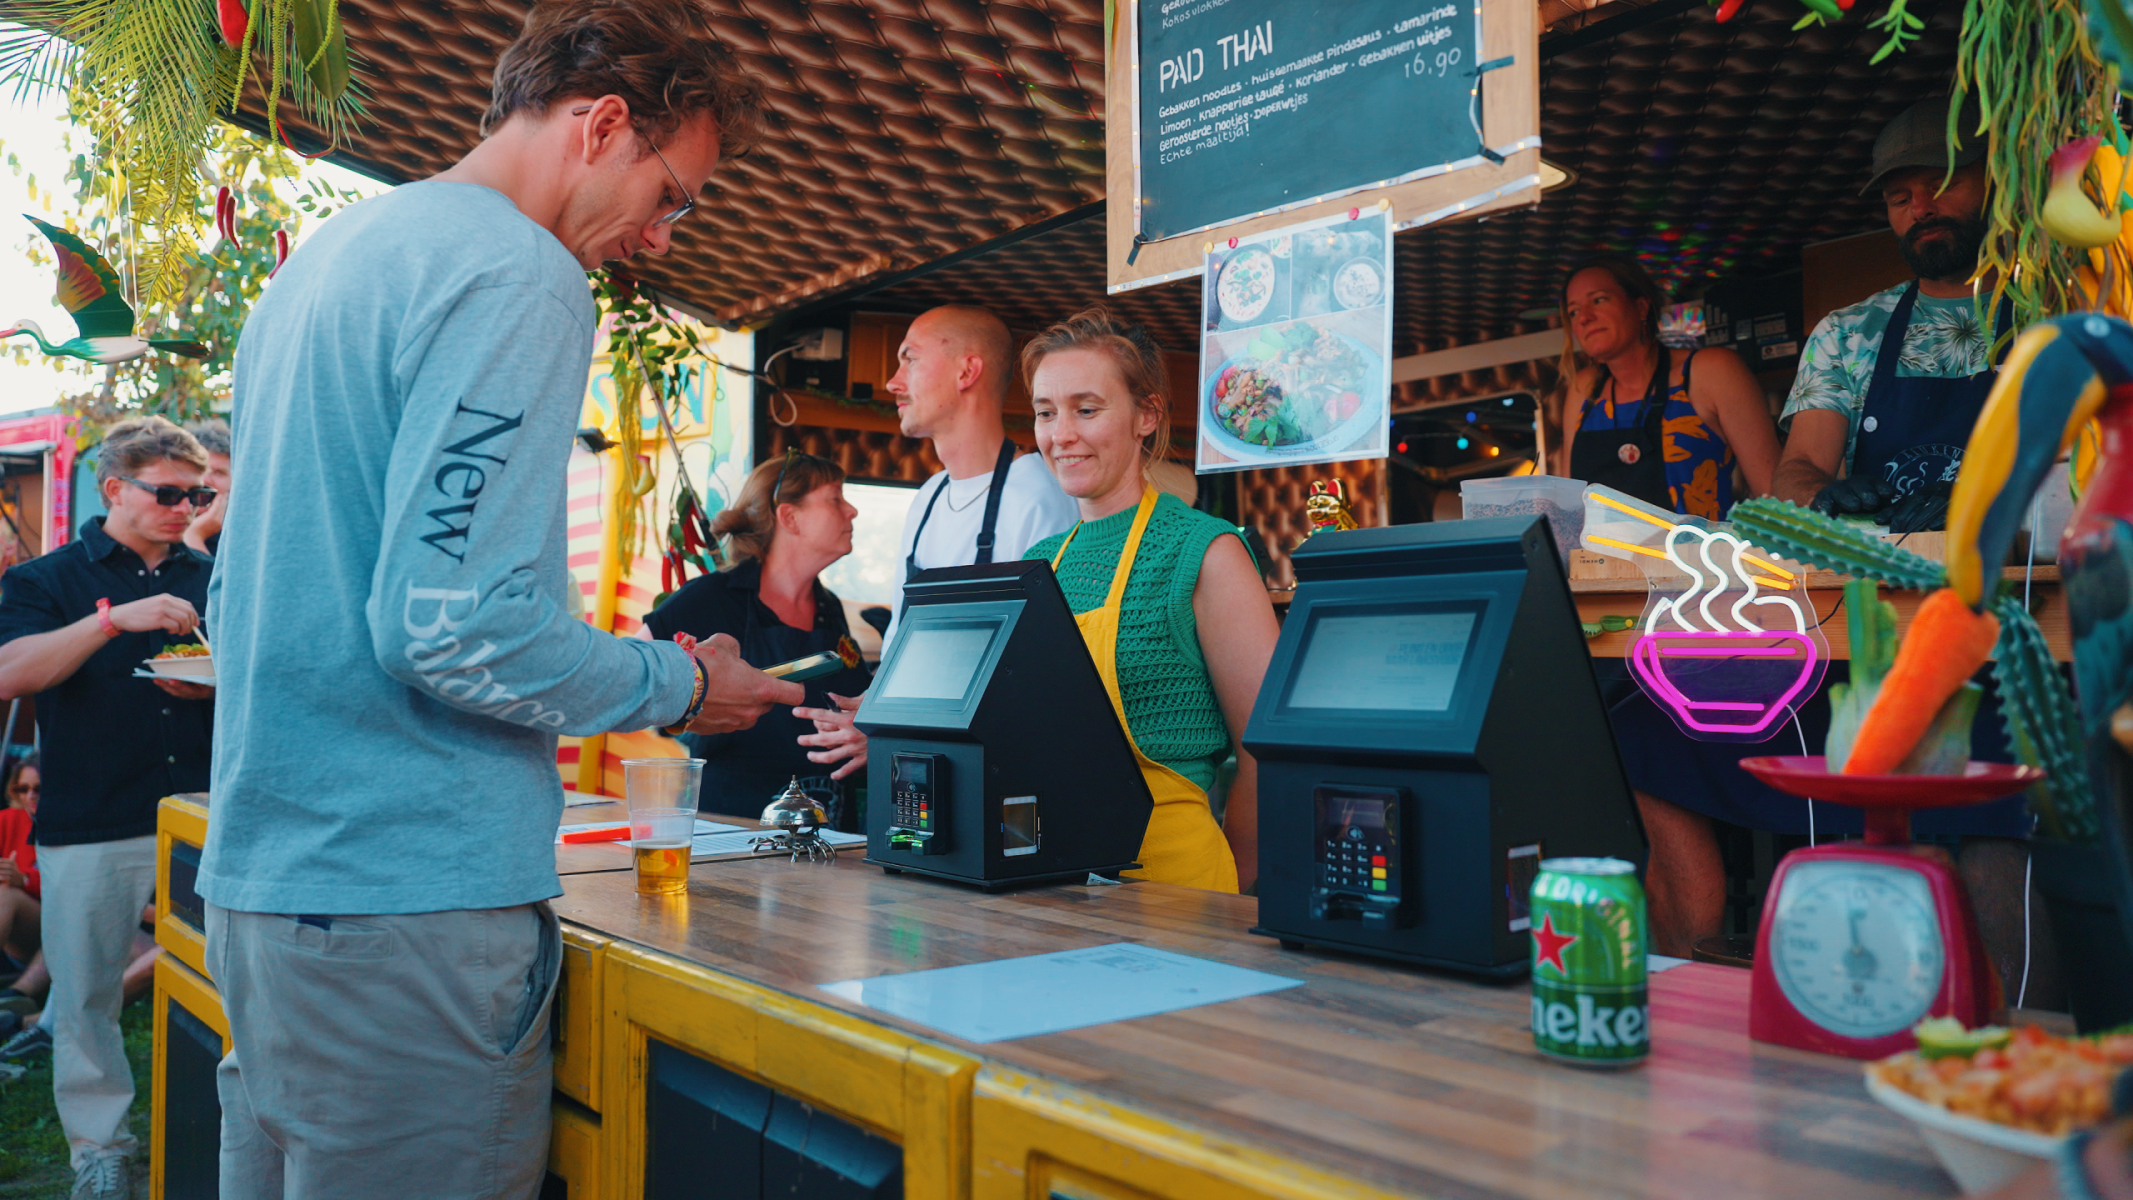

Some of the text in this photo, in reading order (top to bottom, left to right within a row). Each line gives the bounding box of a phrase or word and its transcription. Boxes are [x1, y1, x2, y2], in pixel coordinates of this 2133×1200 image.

[1159, 97, 1200, 118] Gebakken
[1202, 81, 1242, 103] noodles
[1251, 51, 1324, 86] huisgemaakte
[1393, 4, 1458, 34] tamarinde
[1160, 20, 1273, 93] PAD THAI
[1160, 117, 1191, 136] Limoen
[1416, 25, 1453, 47] uitjes
[1159, 123, 1213, 152] Geroosterde
[1214, 112, 1249, 132] nootjes
[419, 396, 524, 565] New
